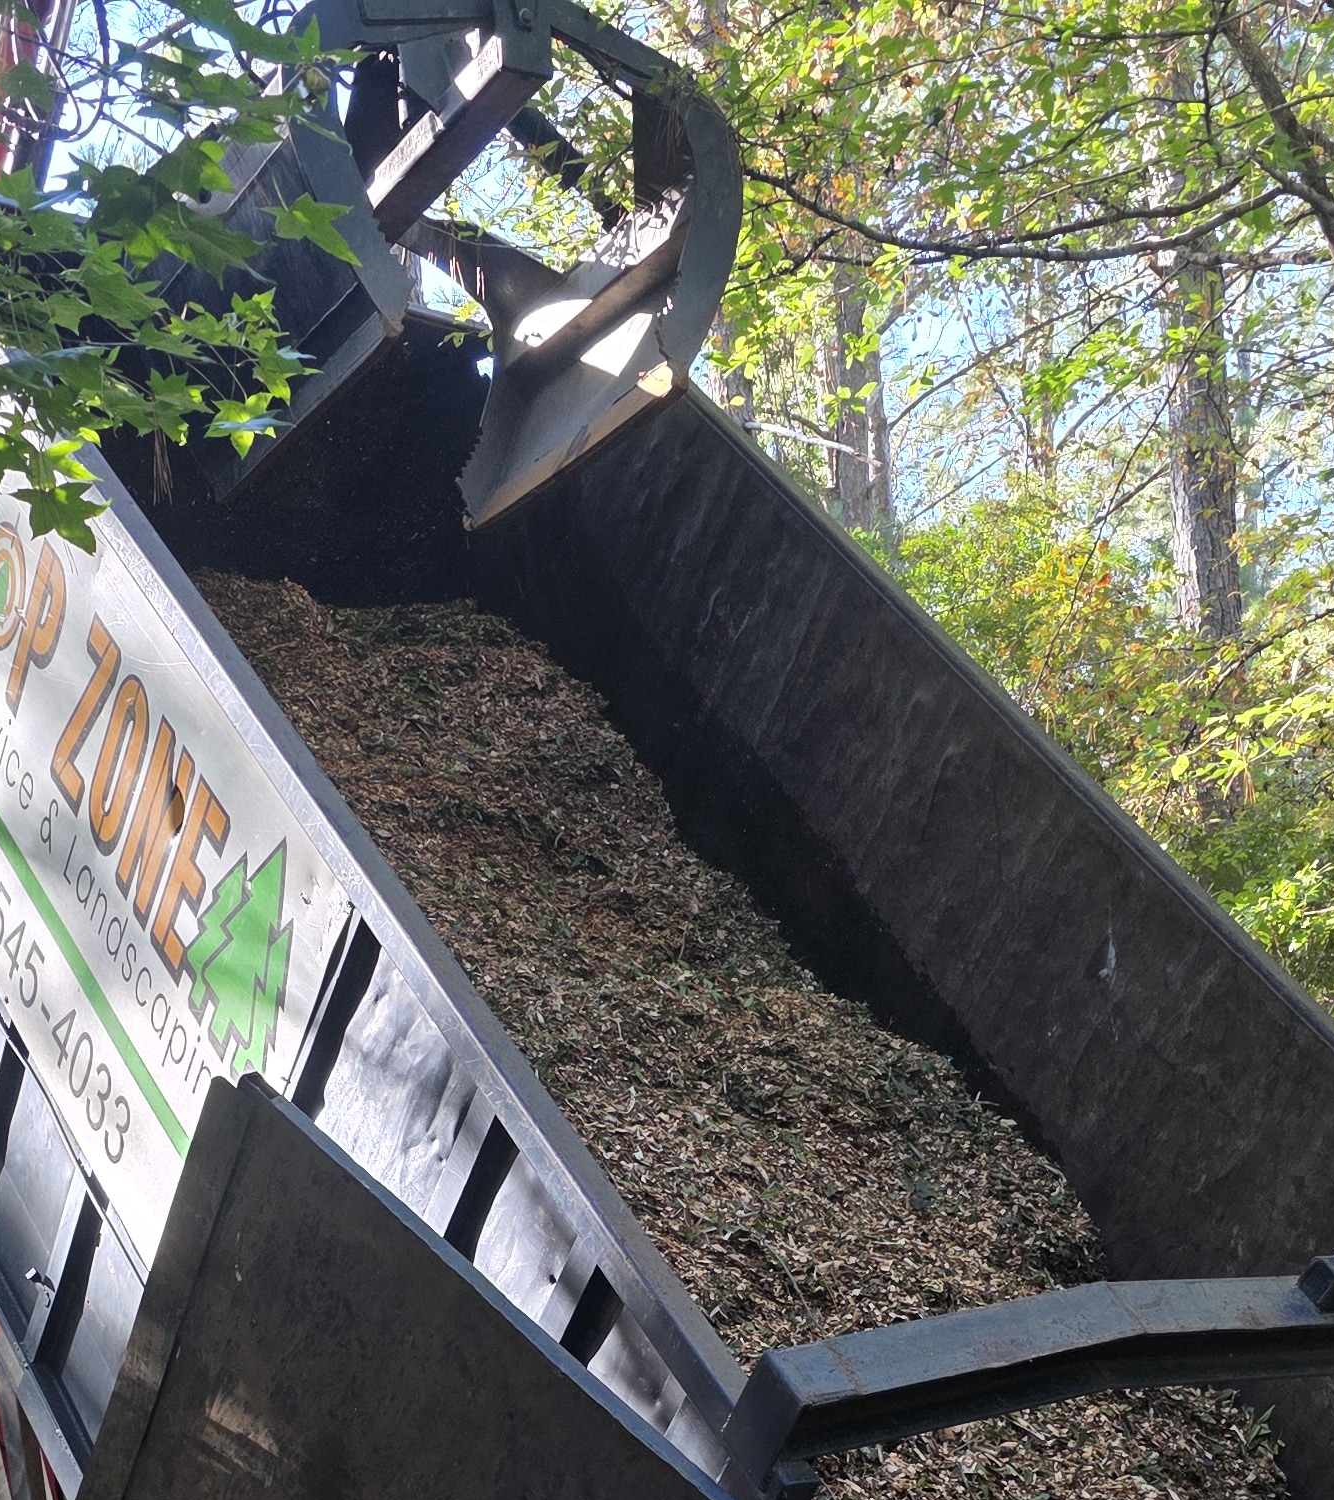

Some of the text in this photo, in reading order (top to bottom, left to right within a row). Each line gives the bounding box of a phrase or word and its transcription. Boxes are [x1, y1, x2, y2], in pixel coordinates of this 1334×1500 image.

[40, 798, 59, 854] &
[62, 834, 212, 1095] Landscapin
[50, 611, 231, 988] ZONE
